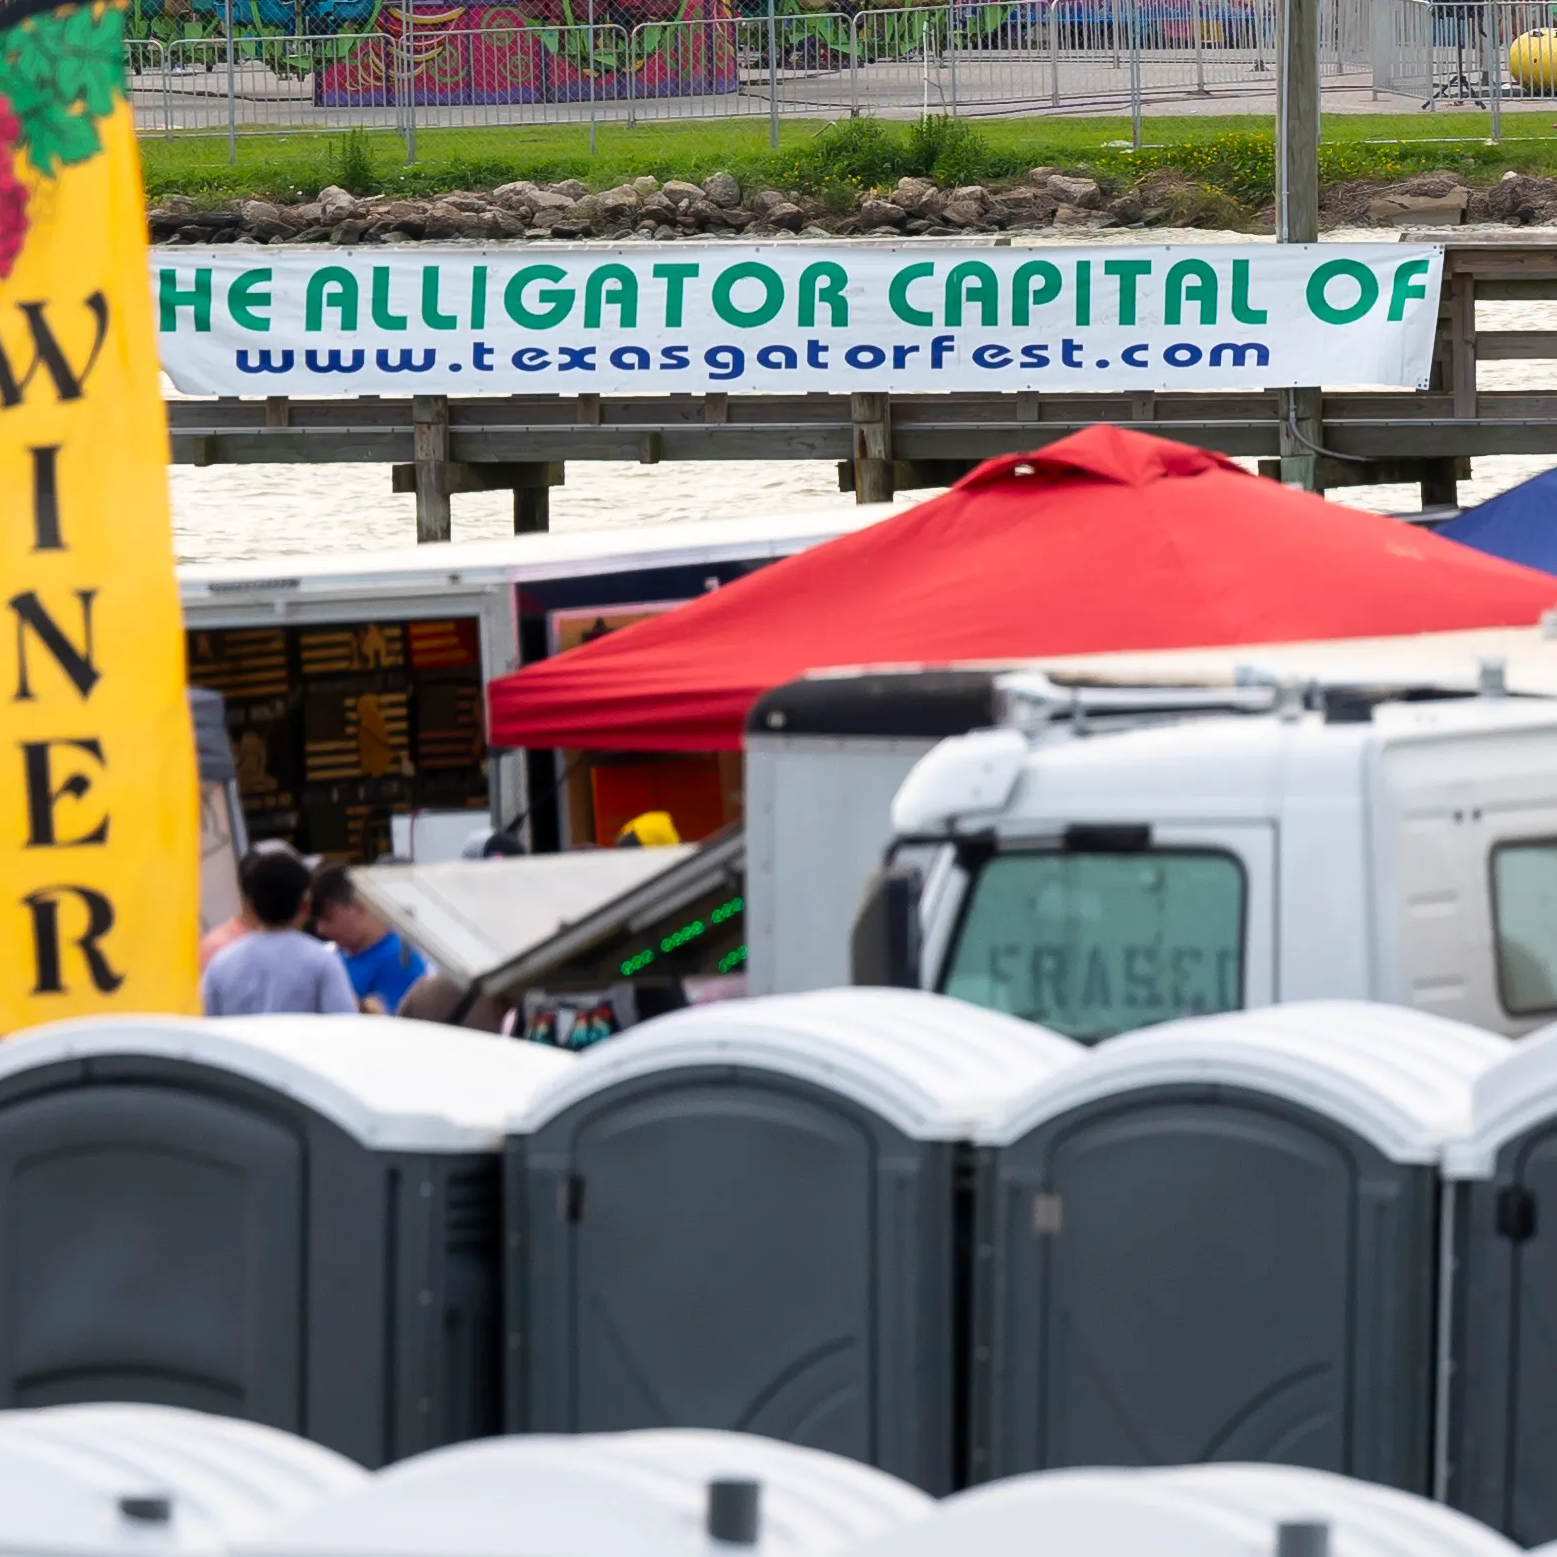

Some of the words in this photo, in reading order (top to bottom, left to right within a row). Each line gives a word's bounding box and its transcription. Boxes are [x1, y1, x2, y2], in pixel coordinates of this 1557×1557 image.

[159, 266, 272, 332] HE
[306, 259, 849, 331] ALLIGATOR
[887, 259, 1268, 330] CAPITAL
[1305, 258, 1431, 326] OF
[237, 334, 1271, 380] www.texasgatorfest.com
